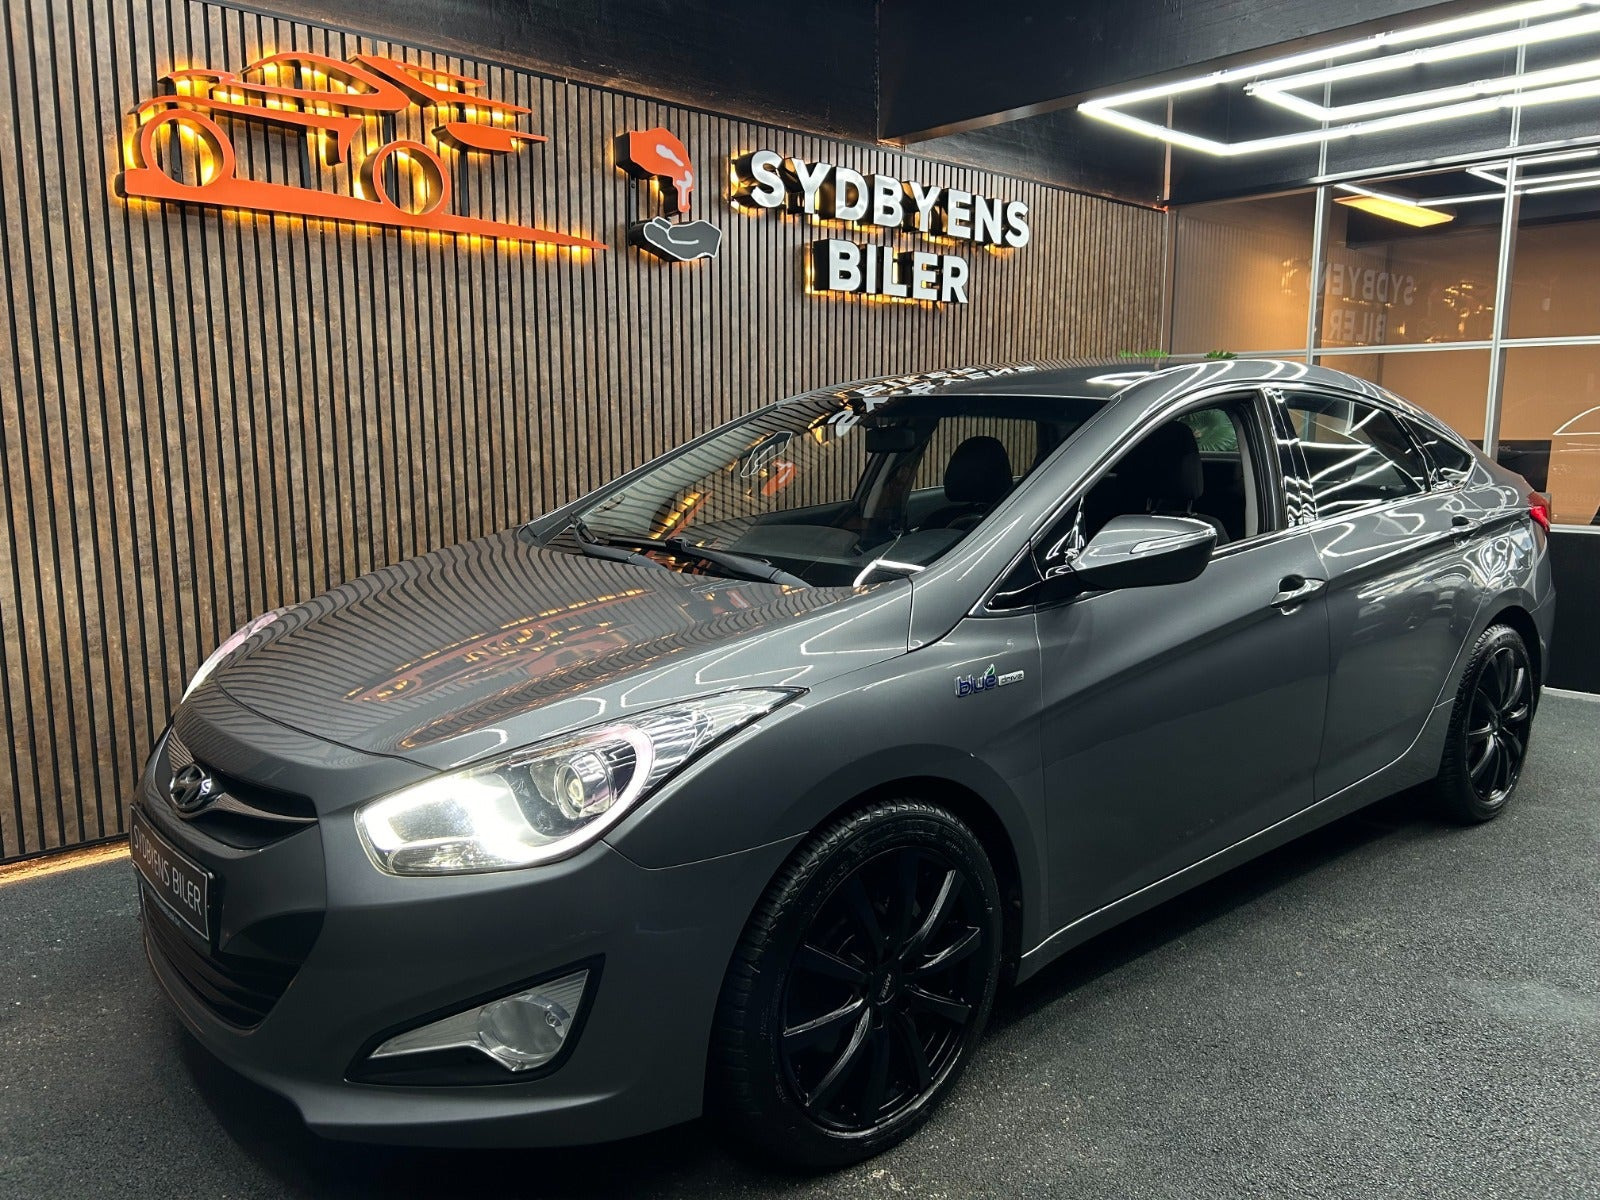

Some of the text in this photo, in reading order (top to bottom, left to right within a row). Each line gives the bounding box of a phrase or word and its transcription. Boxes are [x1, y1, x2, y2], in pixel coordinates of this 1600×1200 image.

[750, 149, 1030, 248] SYDBYENS
[829, 238, 968, 304] BILER
[955, 674, 997, 697] blue
[133, 824, 202, 916] SYDBYENS BILER
